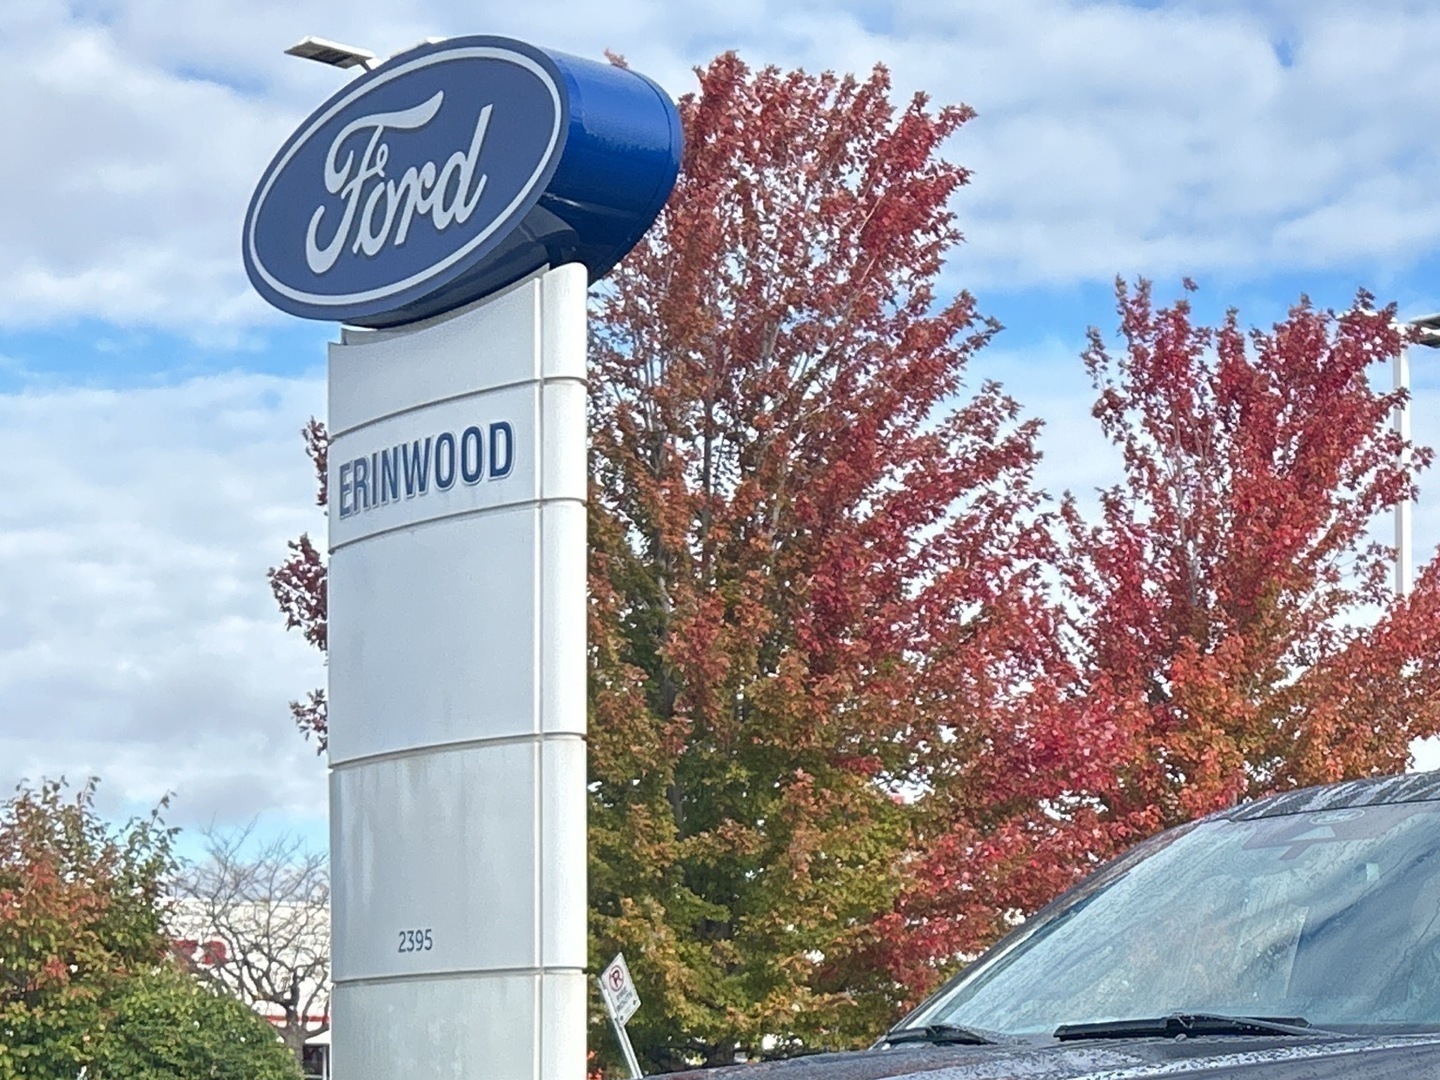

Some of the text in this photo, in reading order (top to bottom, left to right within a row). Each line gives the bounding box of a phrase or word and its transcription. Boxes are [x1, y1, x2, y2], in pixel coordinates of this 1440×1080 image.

[305, 90, 494, 274] Ford
[339, 420, 514, 518] ERINWOOD
[398, 929, 433, 953] 2395
